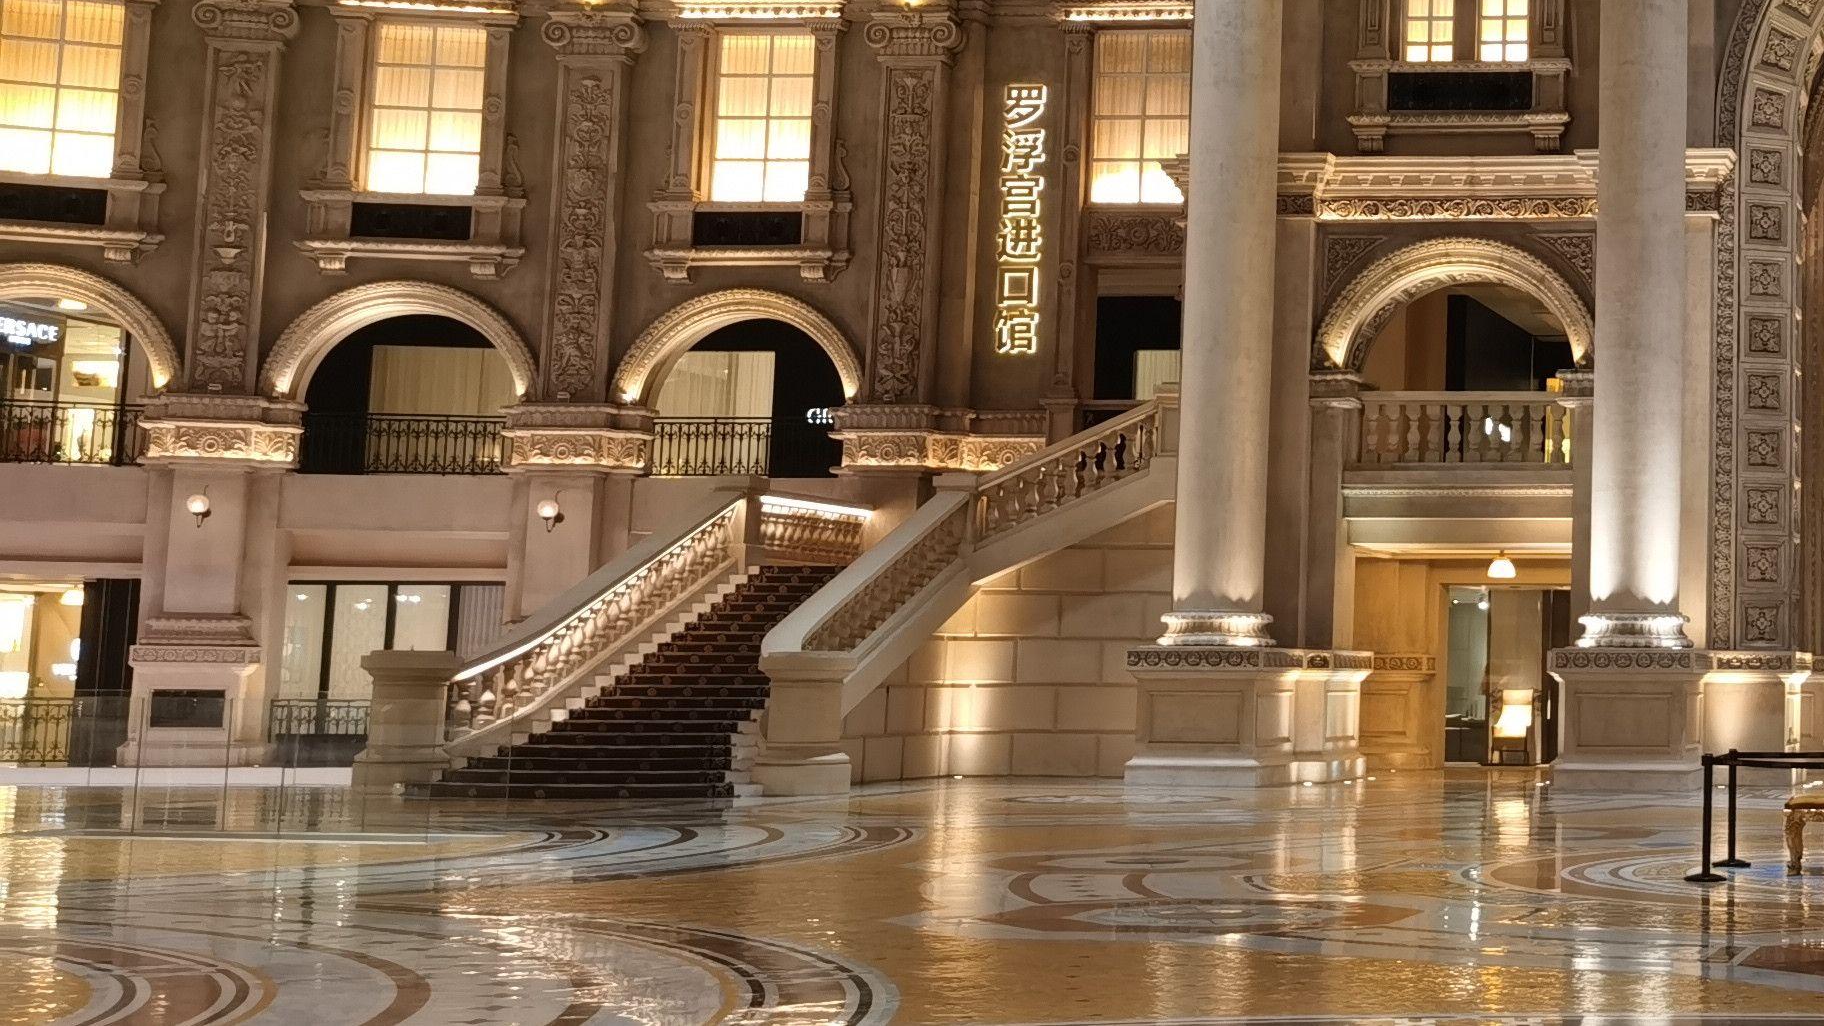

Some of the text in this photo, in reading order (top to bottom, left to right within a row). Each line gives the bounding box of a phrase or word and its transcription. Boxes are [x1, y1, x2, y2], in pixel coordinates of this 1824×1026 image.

[995, 84, 1047, 354] 罗浮宫进口馆
